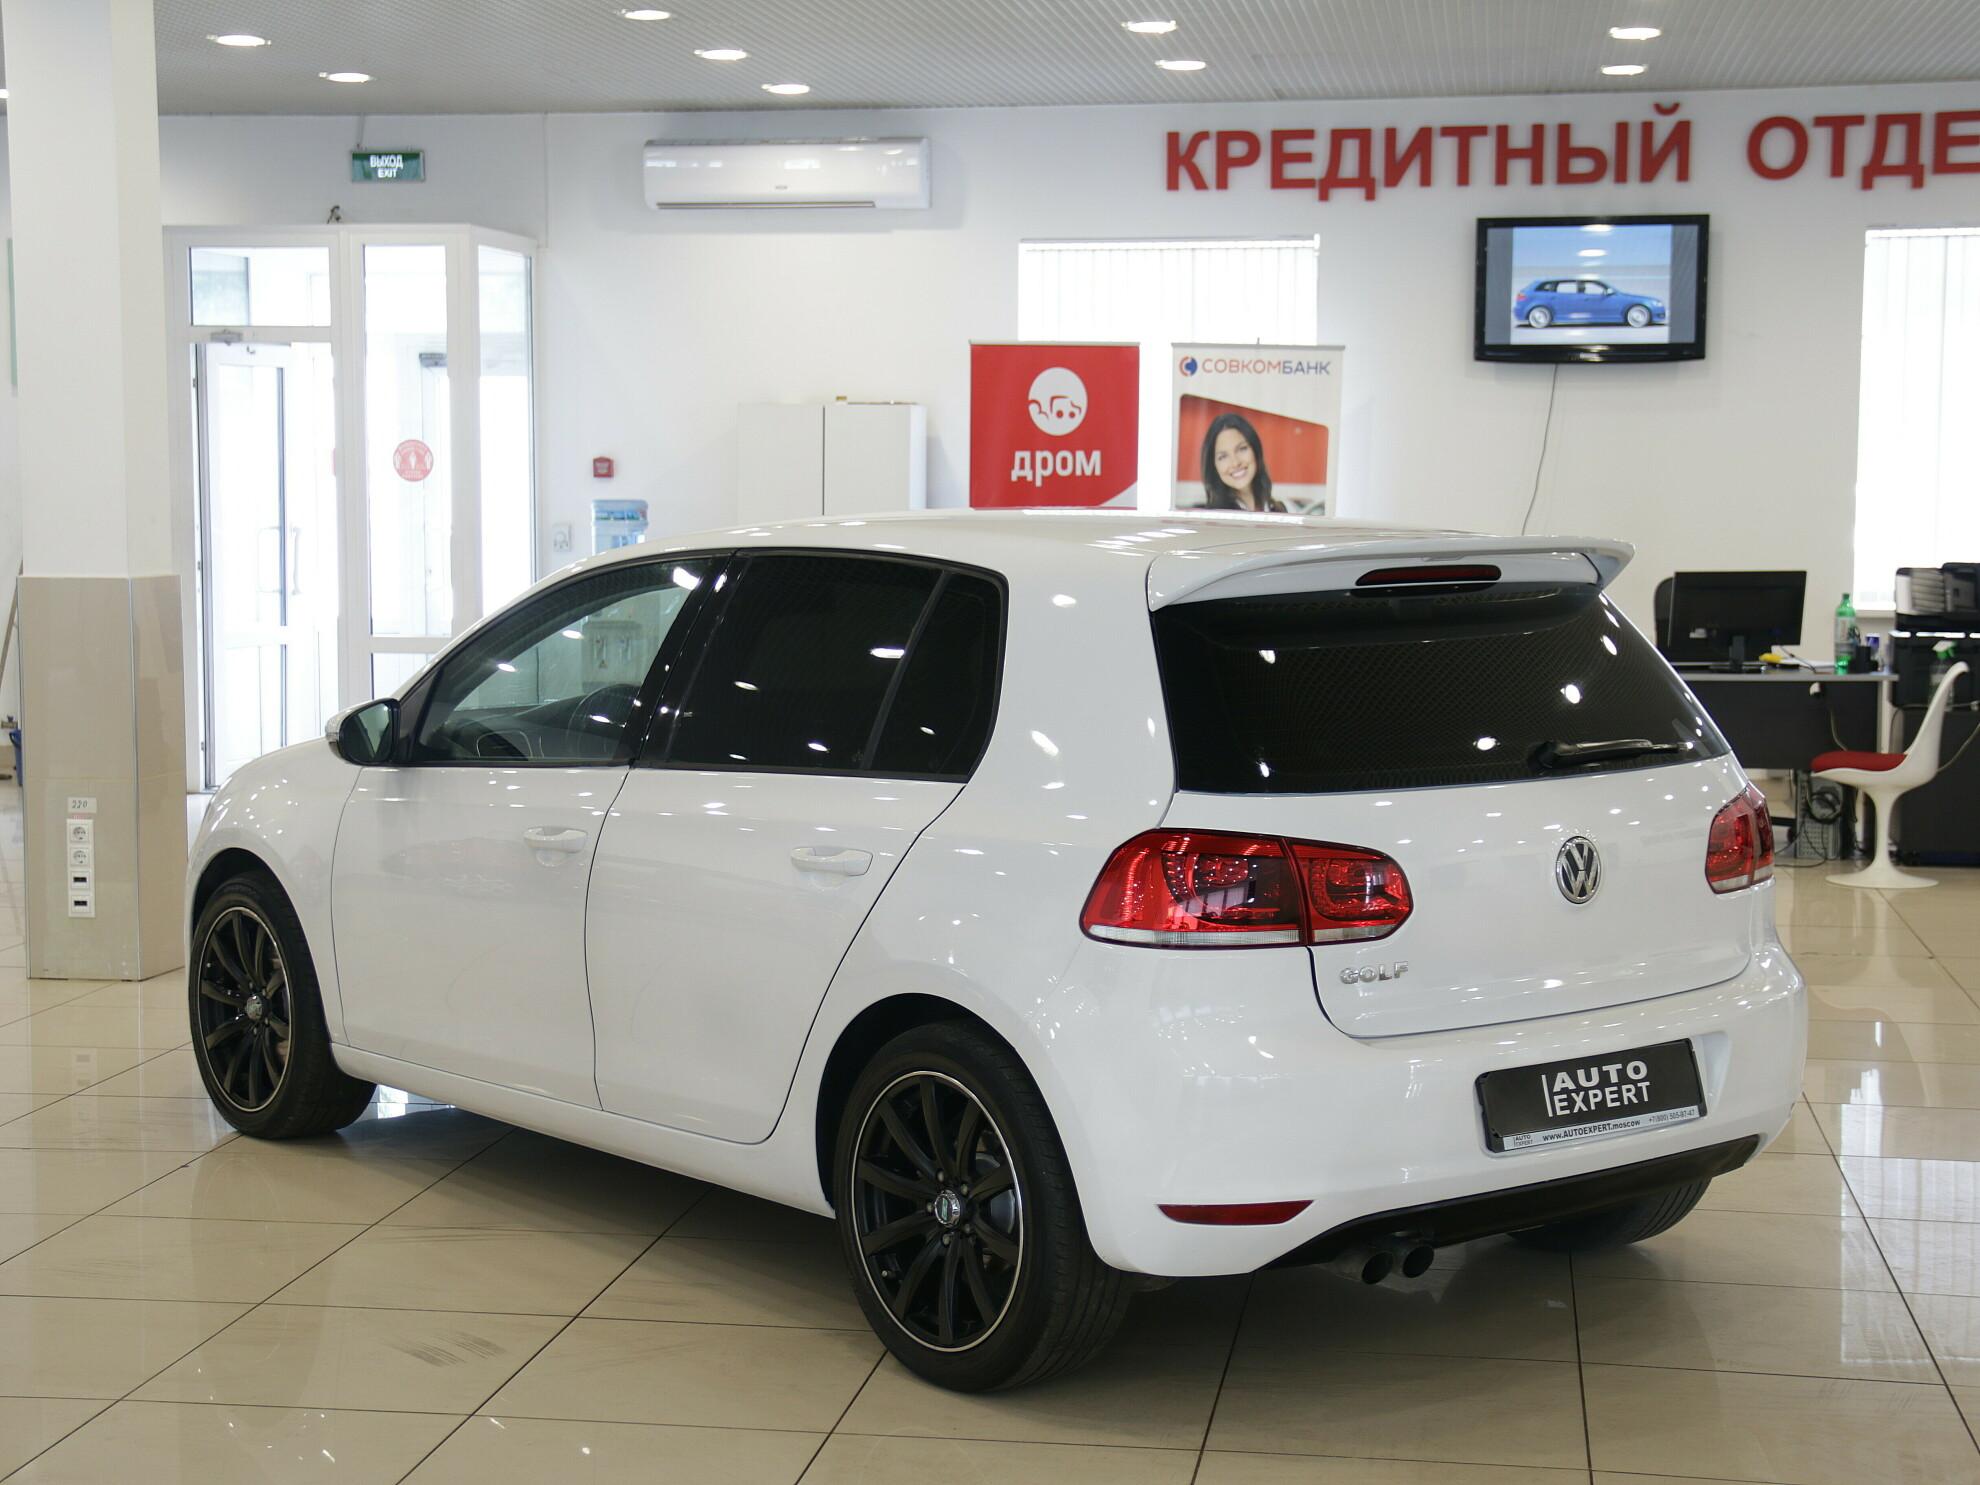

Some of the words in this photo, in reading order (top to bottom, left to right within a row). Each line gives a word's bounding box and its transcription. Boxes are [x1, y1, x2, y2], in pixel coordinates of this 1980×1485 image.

[370, 155, 404, 169] ВЫХОД
[1166, 103, 1691, 201] КРЕДИТНЫЙ
[377, 168, 397, 178] EXIT
[1202, 358, 1332, 376] СОВКОМБАНК
[1339, 960, 1409, 985] GOLF
[1553, 1060, 1648, 1092] AUTO
[1554, 1082, 1651, 1116] EXPERT
[1542, 1119, 1641, 1142] www.AUTOEXPERT.moscow
